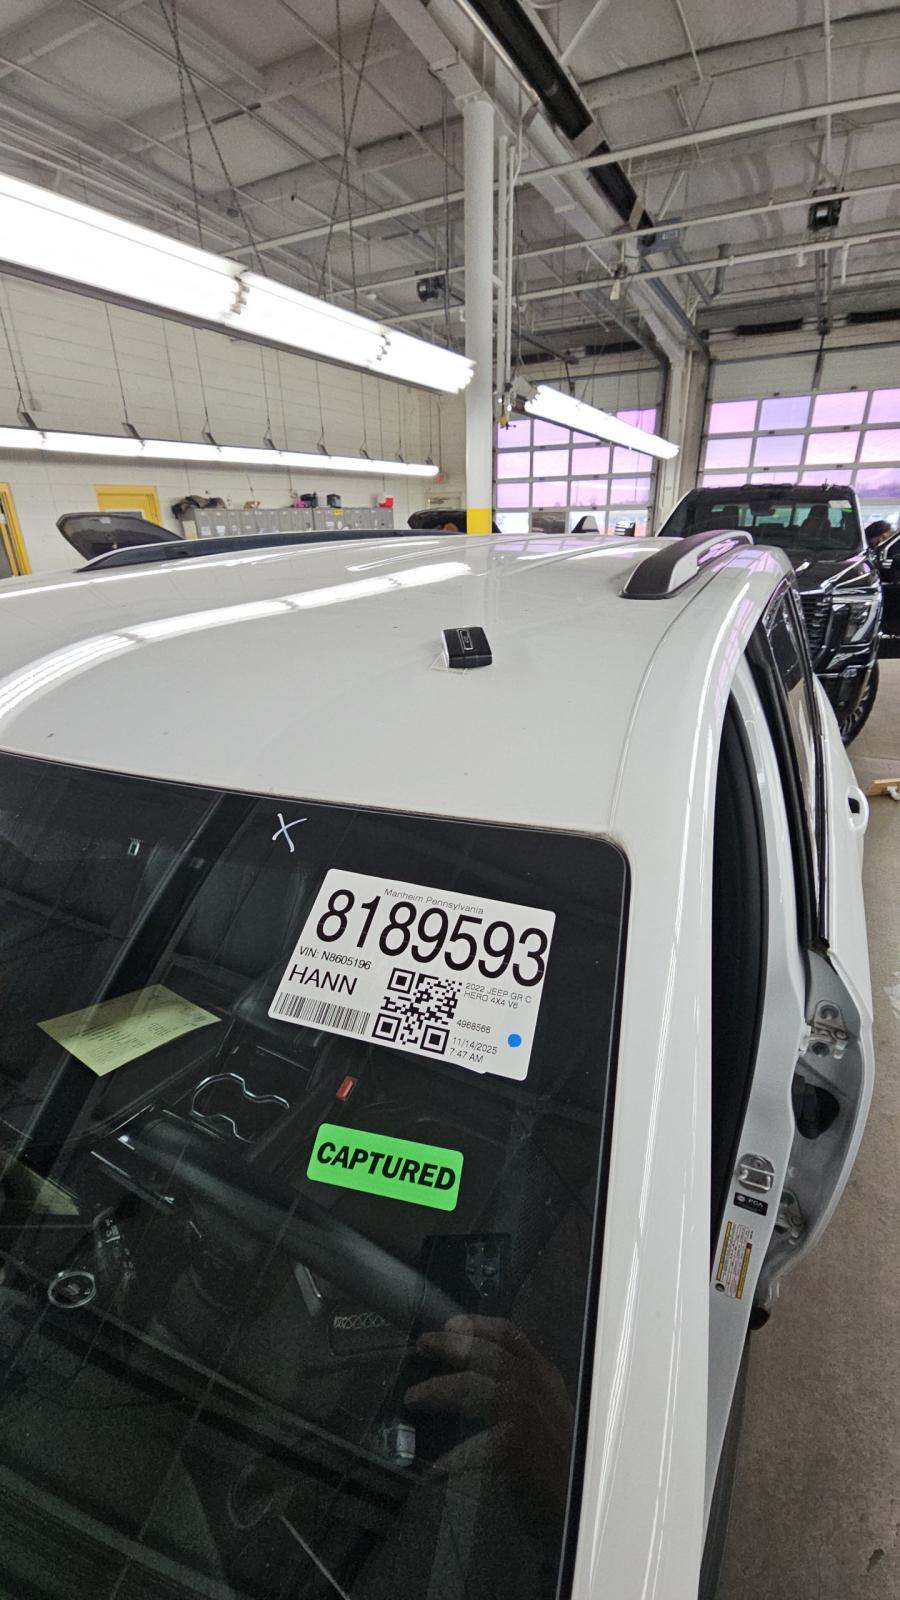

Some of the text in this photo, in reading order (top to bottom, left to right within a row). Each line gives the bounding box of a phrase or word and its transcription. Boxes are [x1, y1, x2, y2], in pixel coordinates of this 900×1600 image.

[384, 888, 484, 915] Manheim Pennsylvania
[316, 889, 548, 987] 8189593
[299, 946, 372, 970] VIN: N8605196
[288, 964, 358, 995] HANN
[465, 982, 485, 993] 2022
[487, 987, 509, 997] JEEP
[490, 997, 505, 1006] 4X4
[449, 1047, 484, 1063] 7:47 AM
[453, 1037, 498, 1055] 11/14/2025
[316, 1142, 456, 1190] CAPTURED
